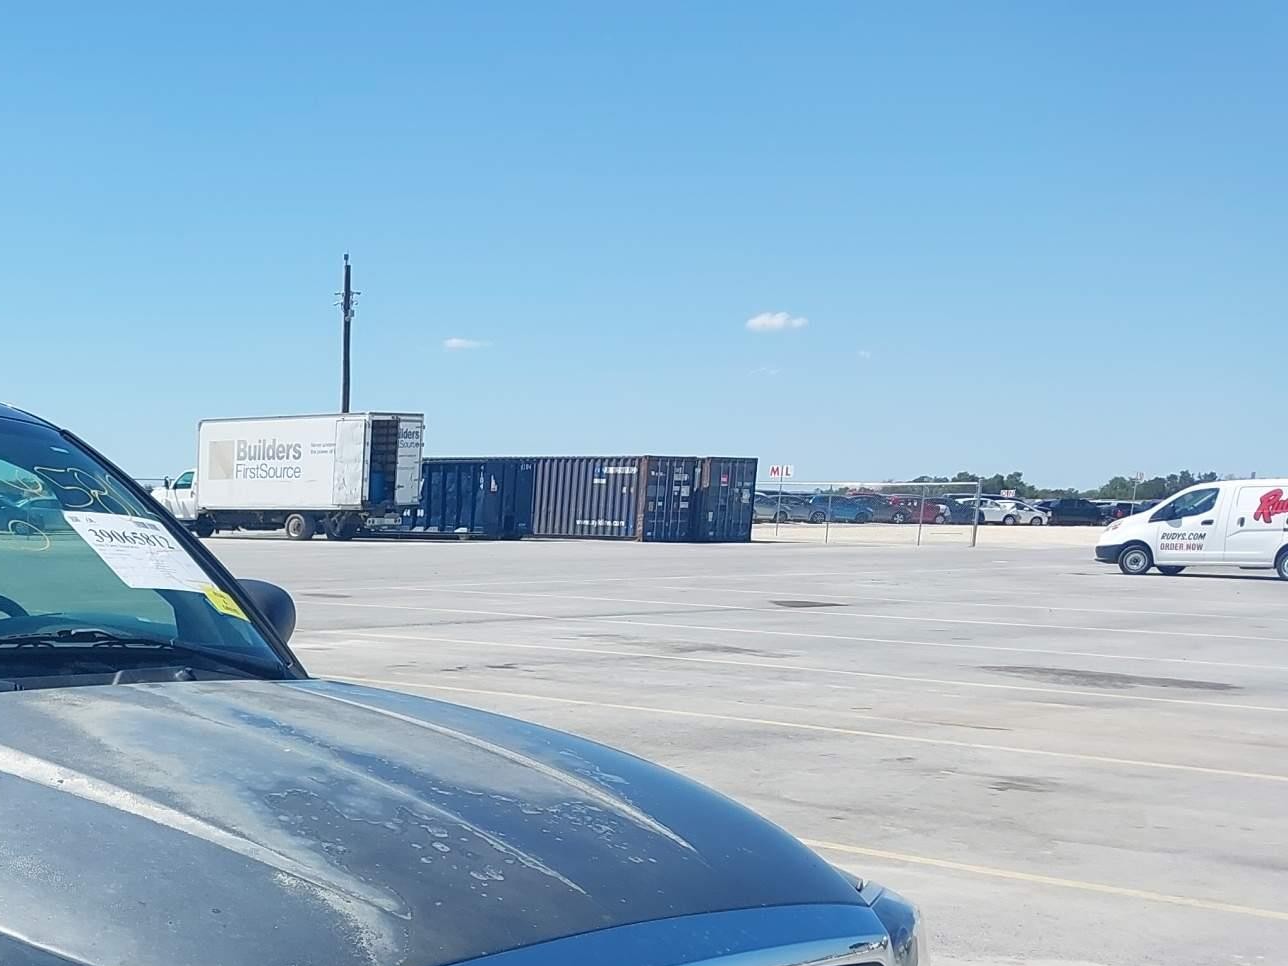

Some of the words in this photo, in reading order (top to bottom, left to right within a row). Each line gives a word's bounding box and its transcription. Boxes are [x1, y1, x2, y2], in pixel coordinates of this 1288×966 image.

[236, 439, 302, 461] Builders
[236, 463, 302, 479] FirstSource
[88, 528, 175, 550] 39065812
[1161, 532, 1207, 541] RUDYS.COM
[1160, 543, 1184, 551] ORDER
[1186, 543, 1204, 551] NOW
